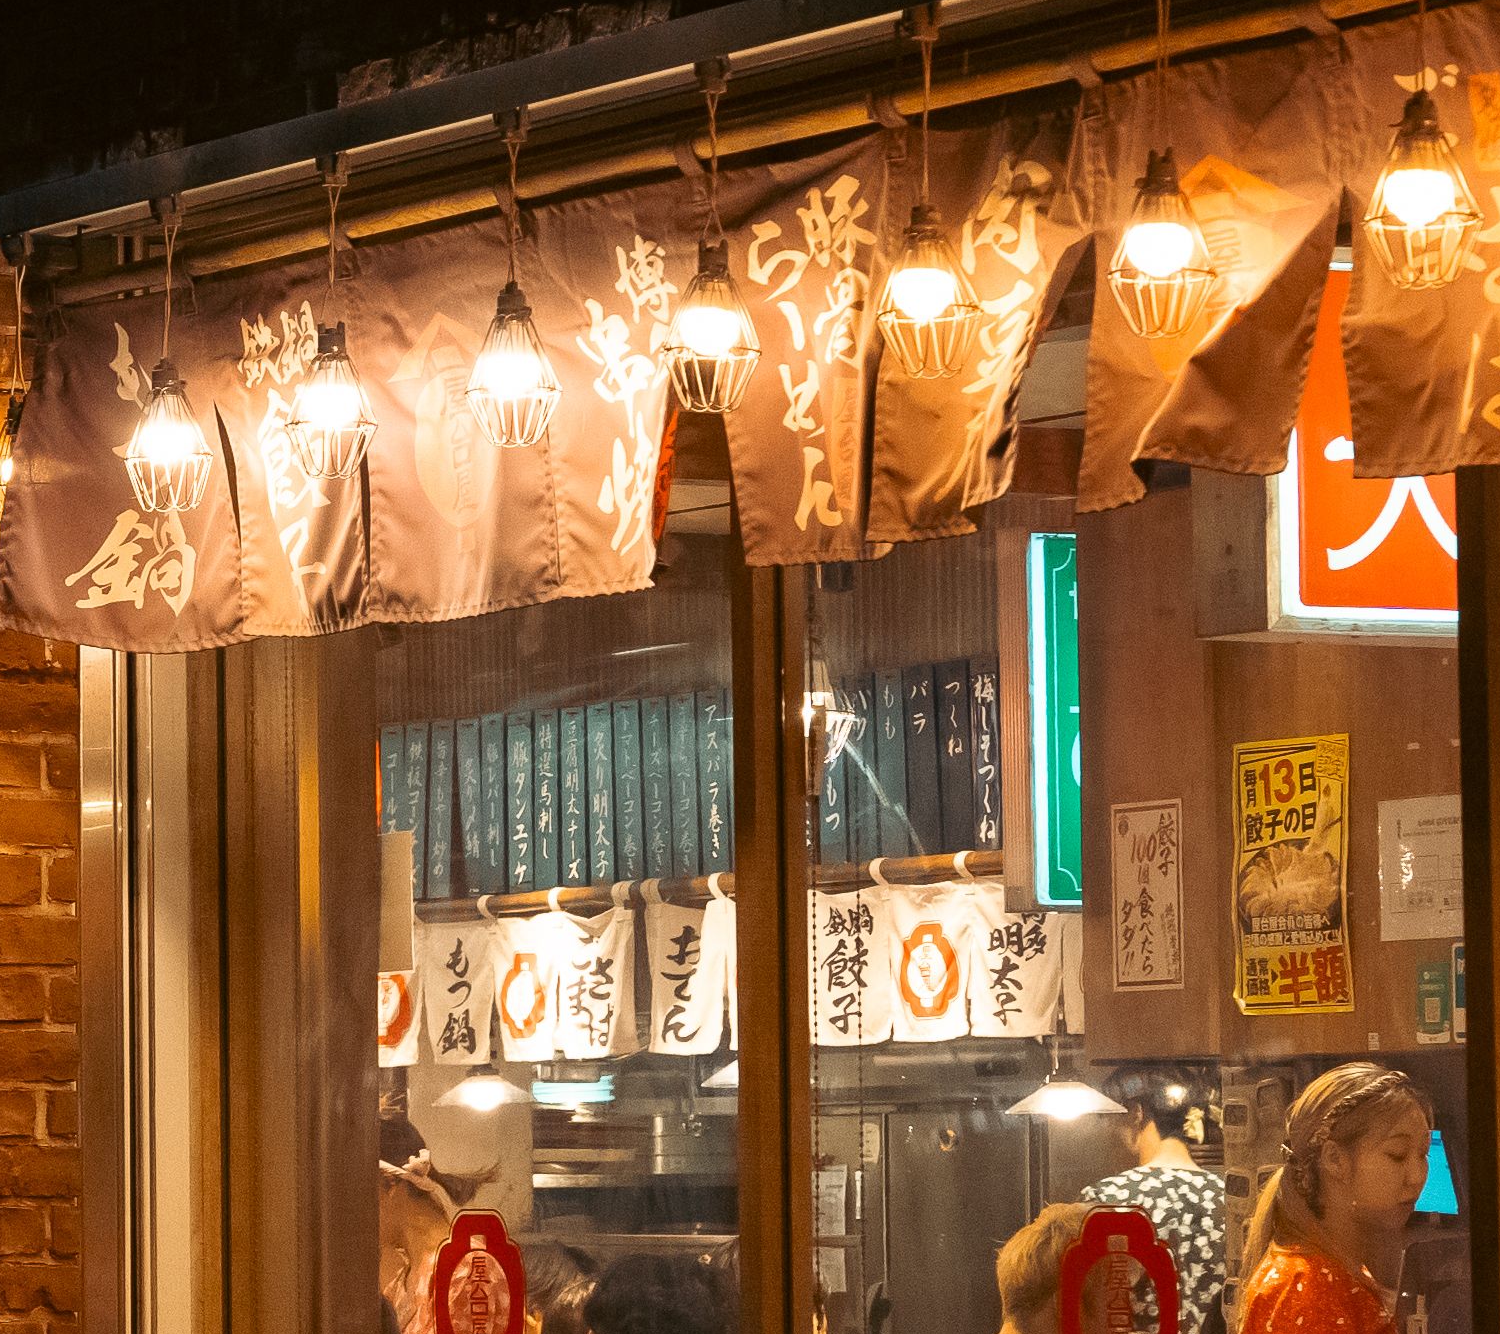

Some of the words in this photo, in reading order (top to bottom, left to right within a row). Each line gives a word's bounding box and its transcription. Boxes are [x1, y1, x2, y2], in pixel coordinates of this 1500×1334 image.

[796, 175, 877, 370] 豚骨
[748, 220, 843, 531] らーめん
[64, 321, 197, 618] も鍋
[883, 684, 896, 740] もも
[910, 680, 929, 735] バラ
[944, 681, 964, 757] つくね
[972, 673, 996, 843] 梅しそつくね
[538, 723, 554, 859] 特選馬刺し
[592, 730, 610, 878] 炙り明太子
[704, 704, 724, 859] アスパラ巻き
[1245, 801, 1317, 846] 餃子の日
[437, 937, 476, 1055] もつ鍋
[821, 935, 869, 1035] 餃子
[987, 921, 1024, 1026] 明太子
[1278, 945, 1349, 1005] 半額
